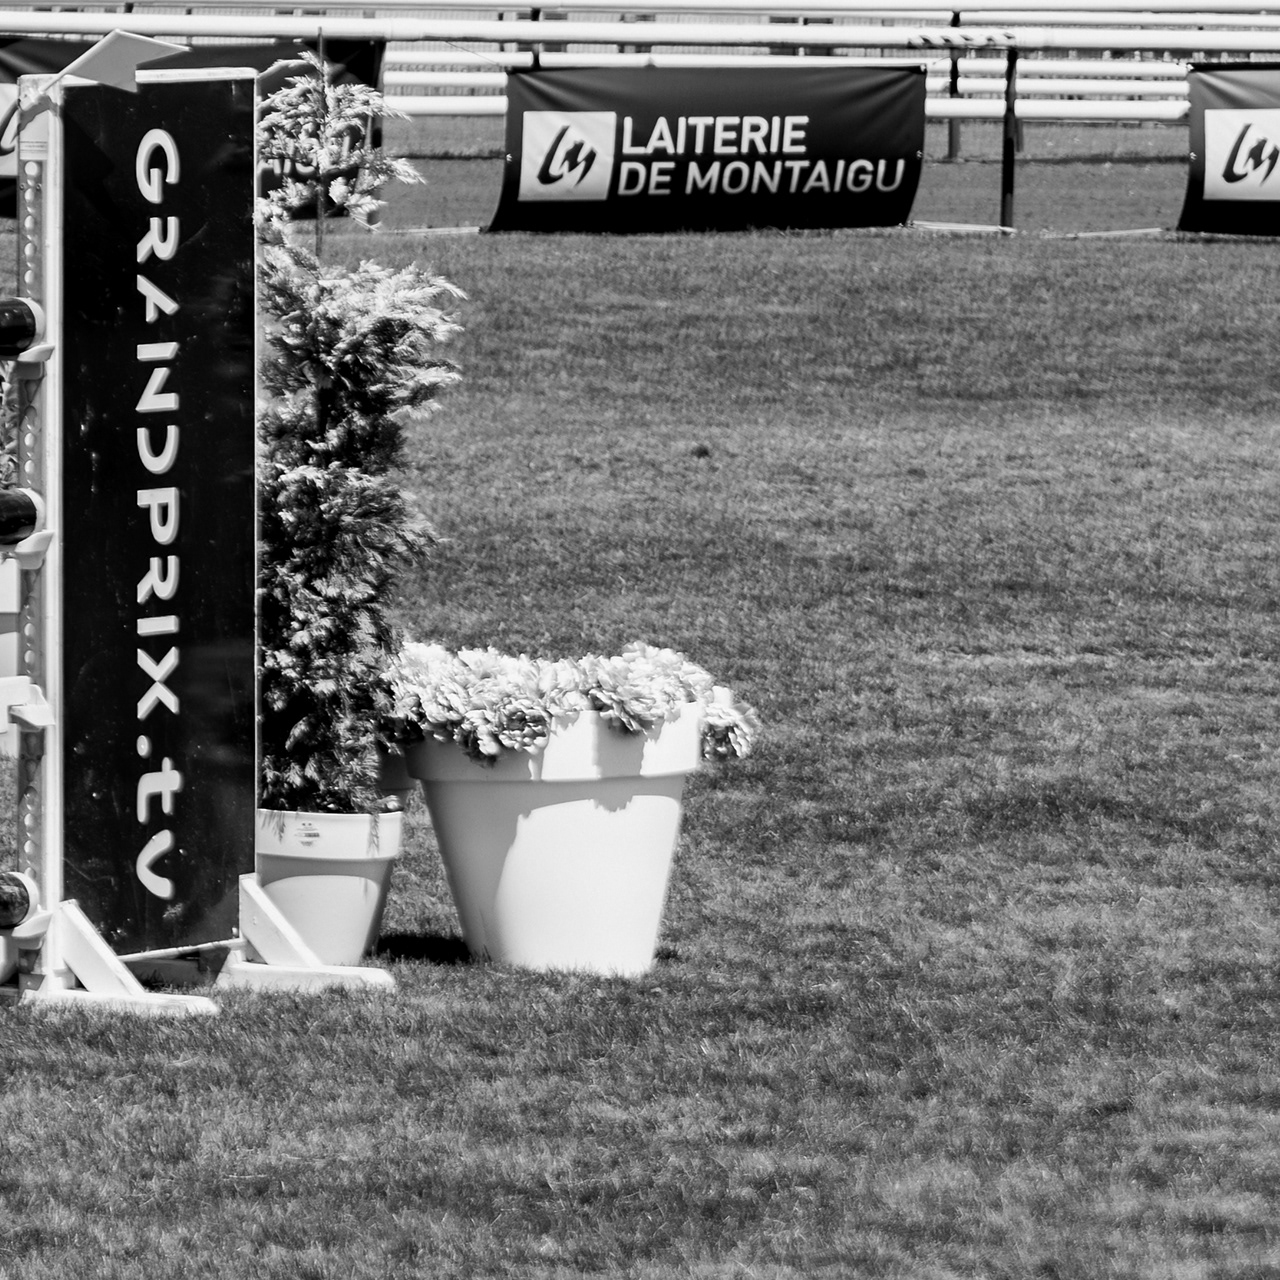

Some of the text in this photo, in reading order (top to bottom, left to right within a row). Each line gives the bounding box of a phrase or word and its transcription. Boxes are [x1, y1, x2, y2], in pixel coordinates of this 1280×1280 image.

[622, 115, 810, 155] LAITERIE
[617, 157, 906, 196] DE MONTAIGU
